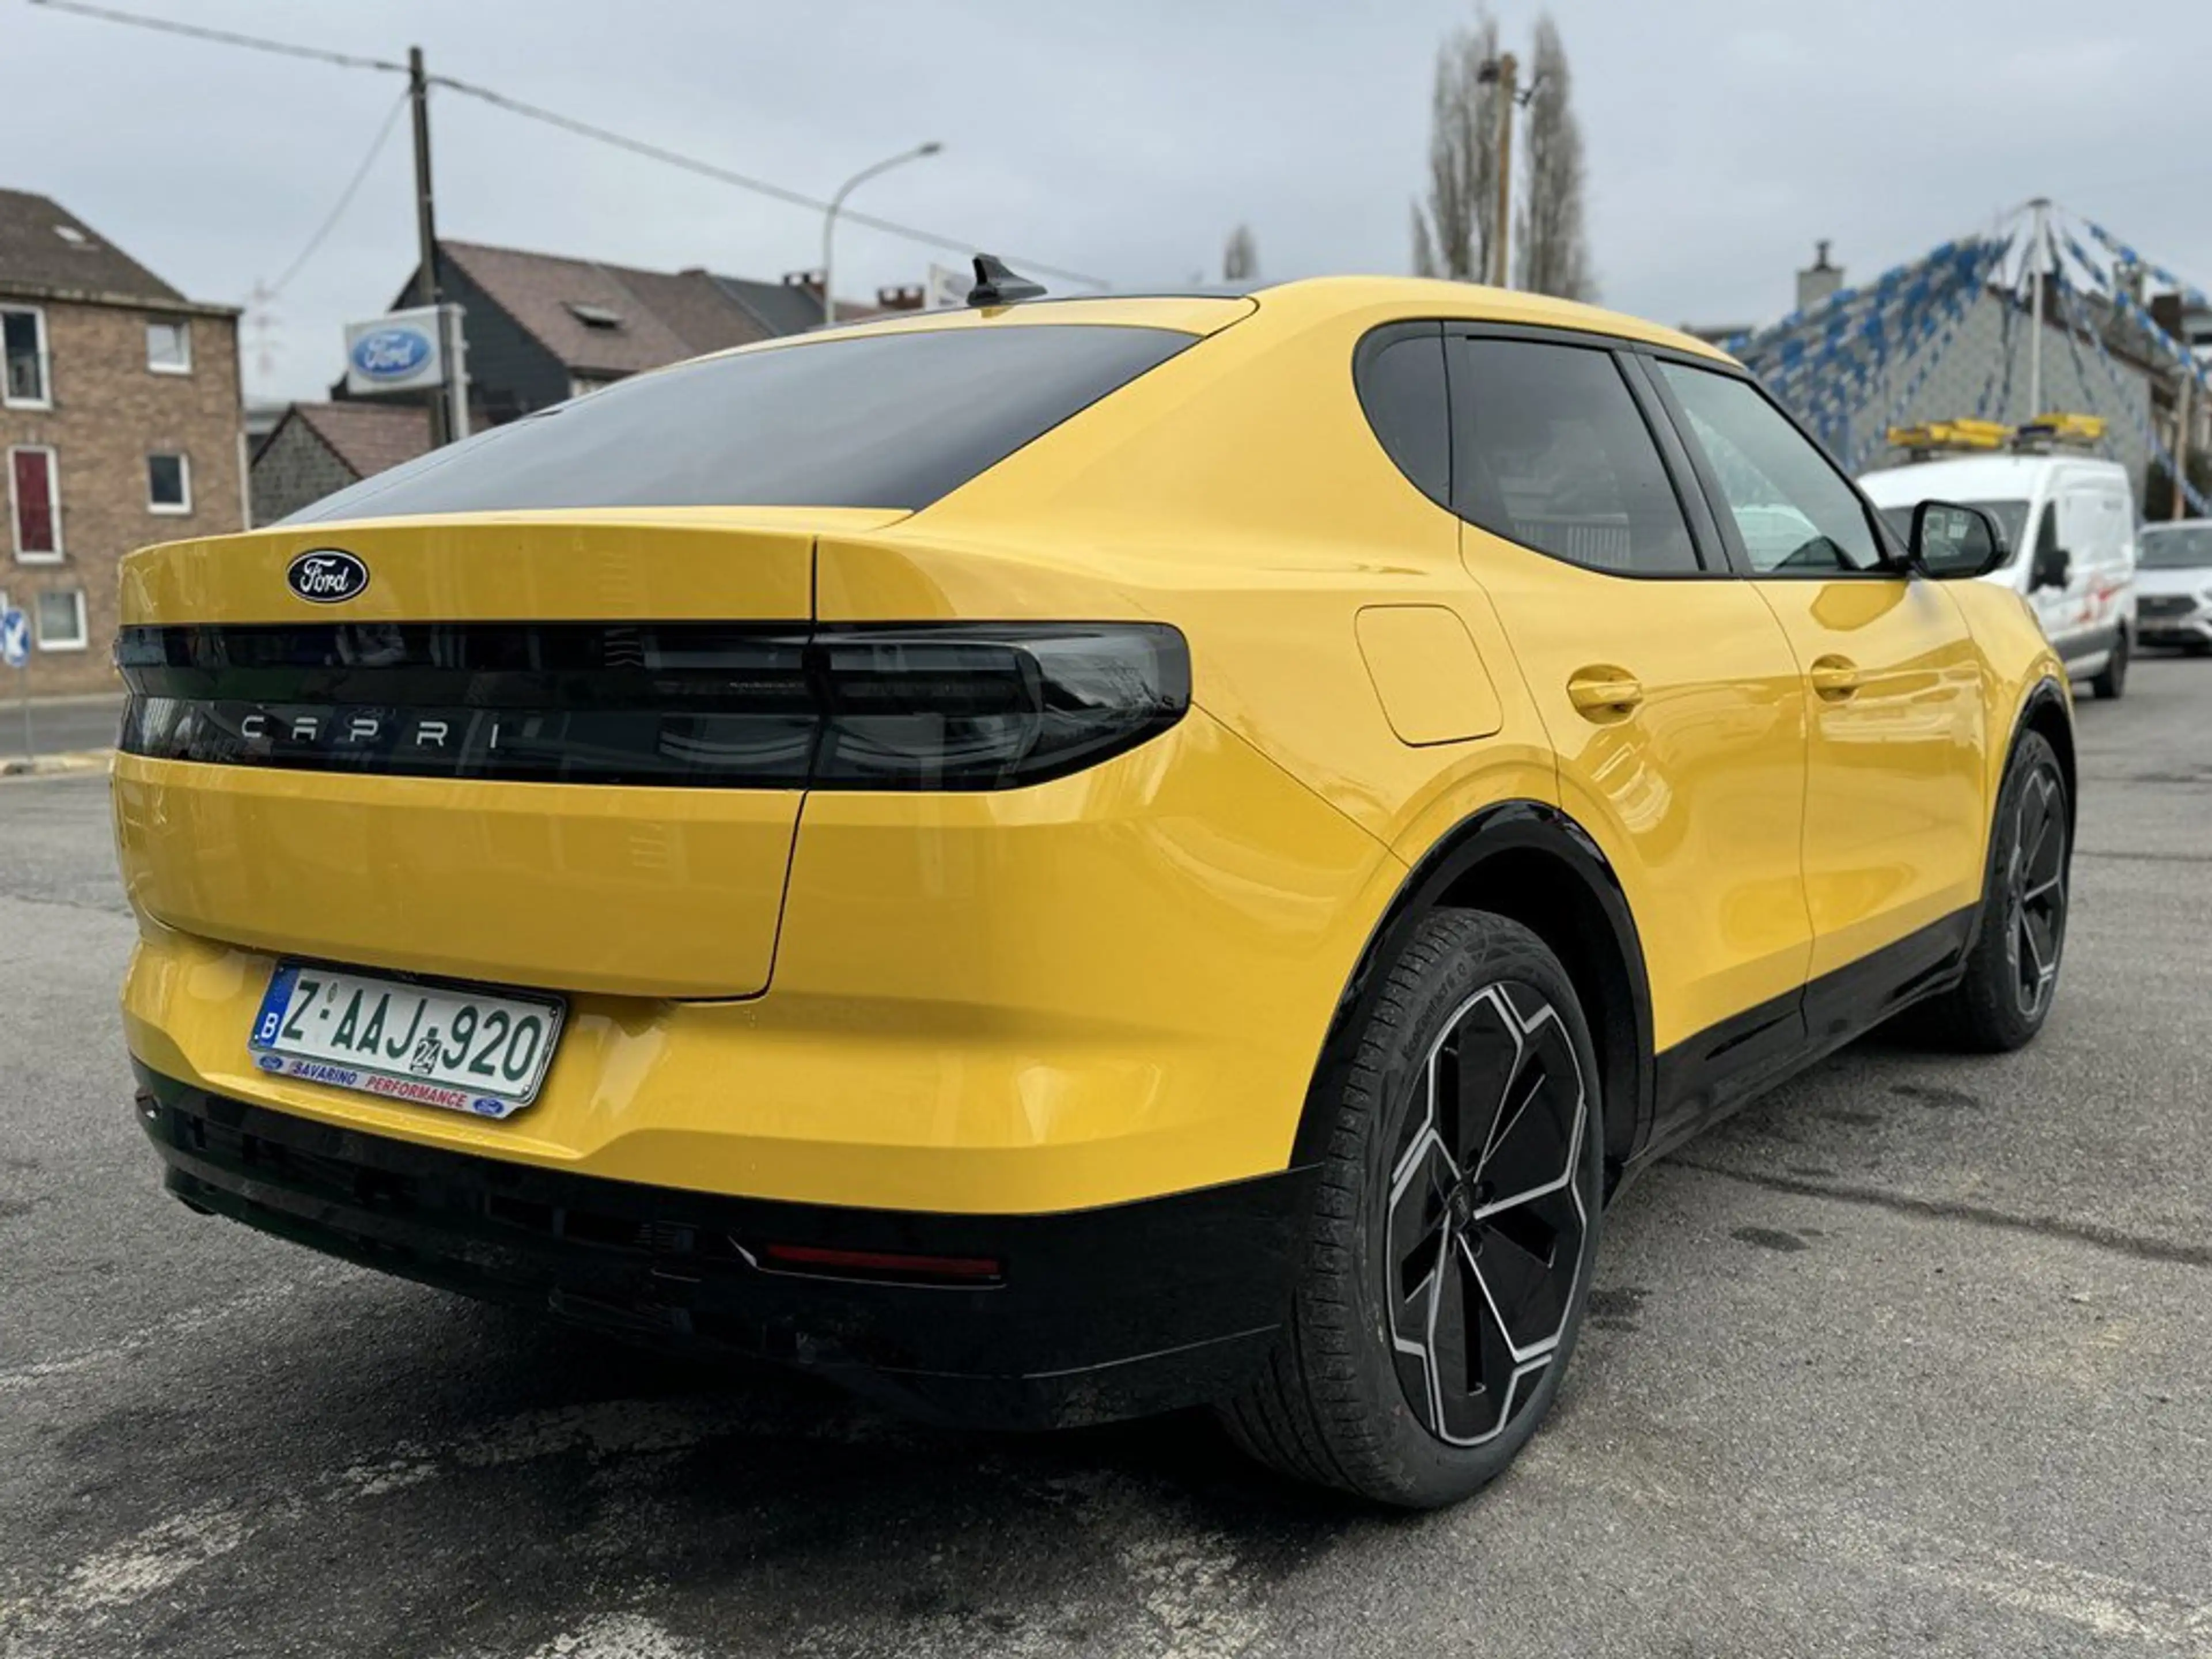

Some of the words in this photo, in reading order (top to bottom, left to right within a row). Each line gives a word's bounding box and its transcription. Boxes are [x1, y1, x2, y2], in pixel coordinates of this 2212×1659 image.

[364, 334, 414, 369] Ford
[300, 558, 349, 593] Ford
[241, 715, 499, 748] CAPRI
[261, 1012, 279, 1039] B
[414, 1041, 440, 1067] 24
[365, 1075, 468, 1108] PERFORMANCE
